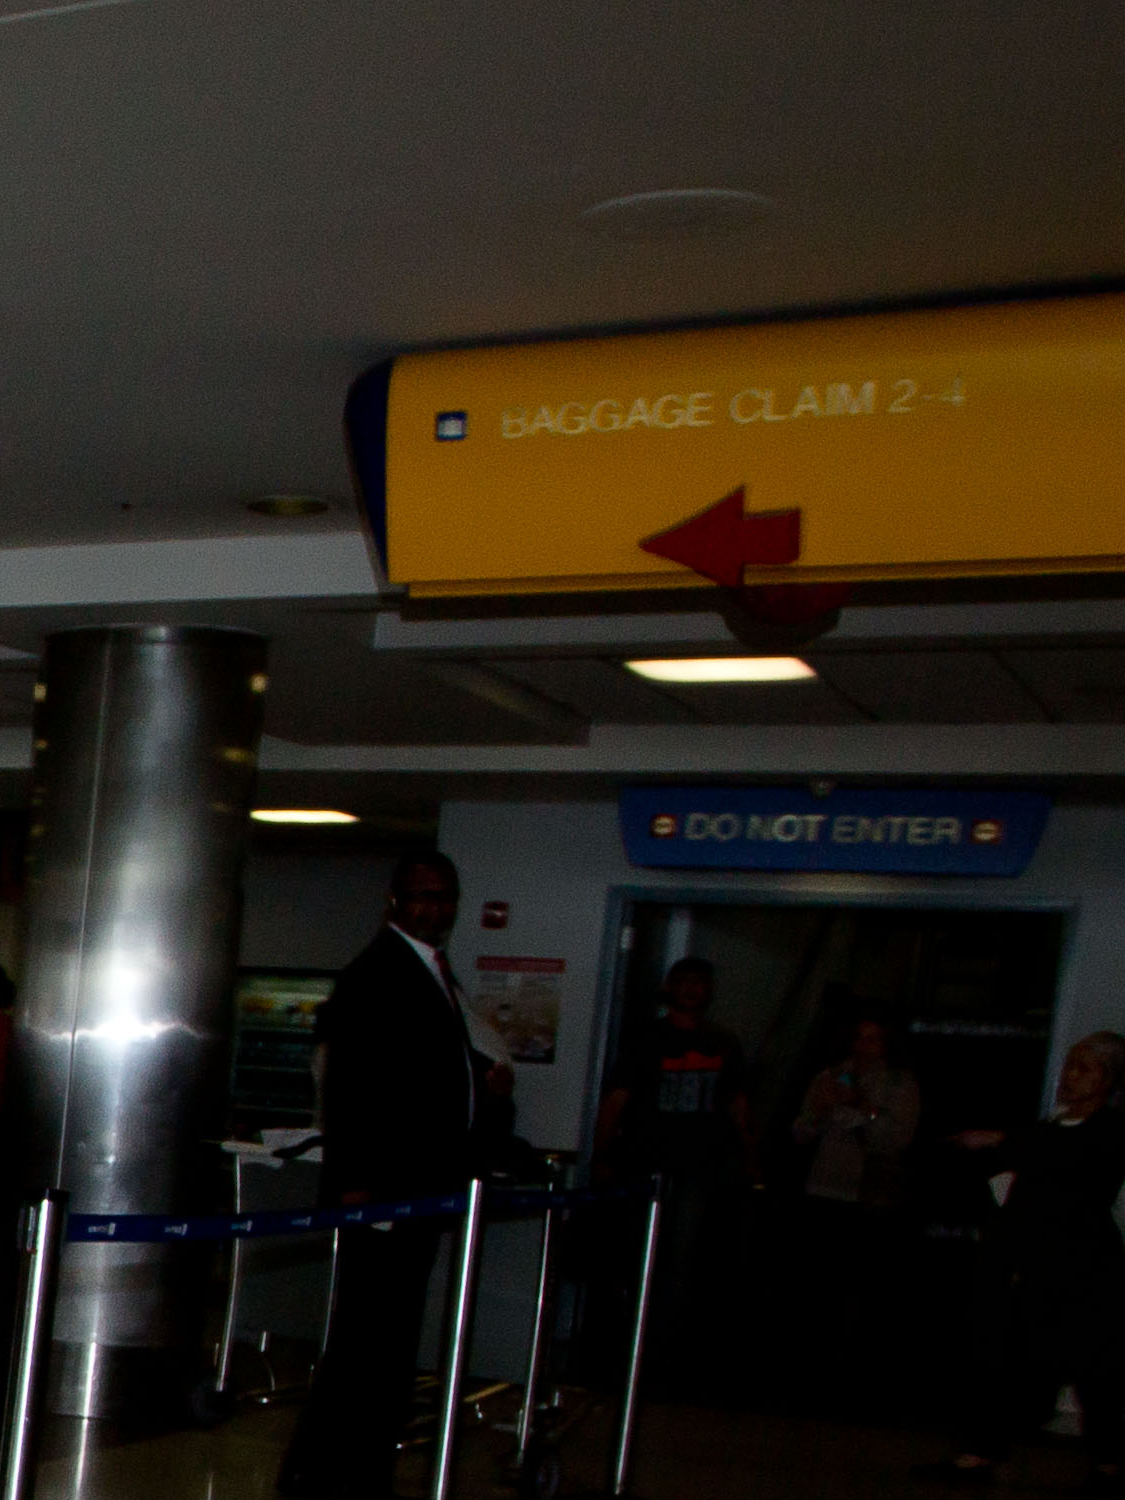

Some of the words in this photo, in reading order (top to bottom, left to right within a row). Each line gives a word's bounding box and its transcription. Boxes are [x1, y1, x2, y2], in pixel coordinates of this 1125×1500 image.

[501, 392, 713, 439] BAGGAGE
[729, 379, 876, 424] CLAIM
[888, 376, 966, 414] 2-4
[683, 812, 742, 841] DO
[746, 813, 829, 844] NOT
[831, 815, 964, 846] ENTER
